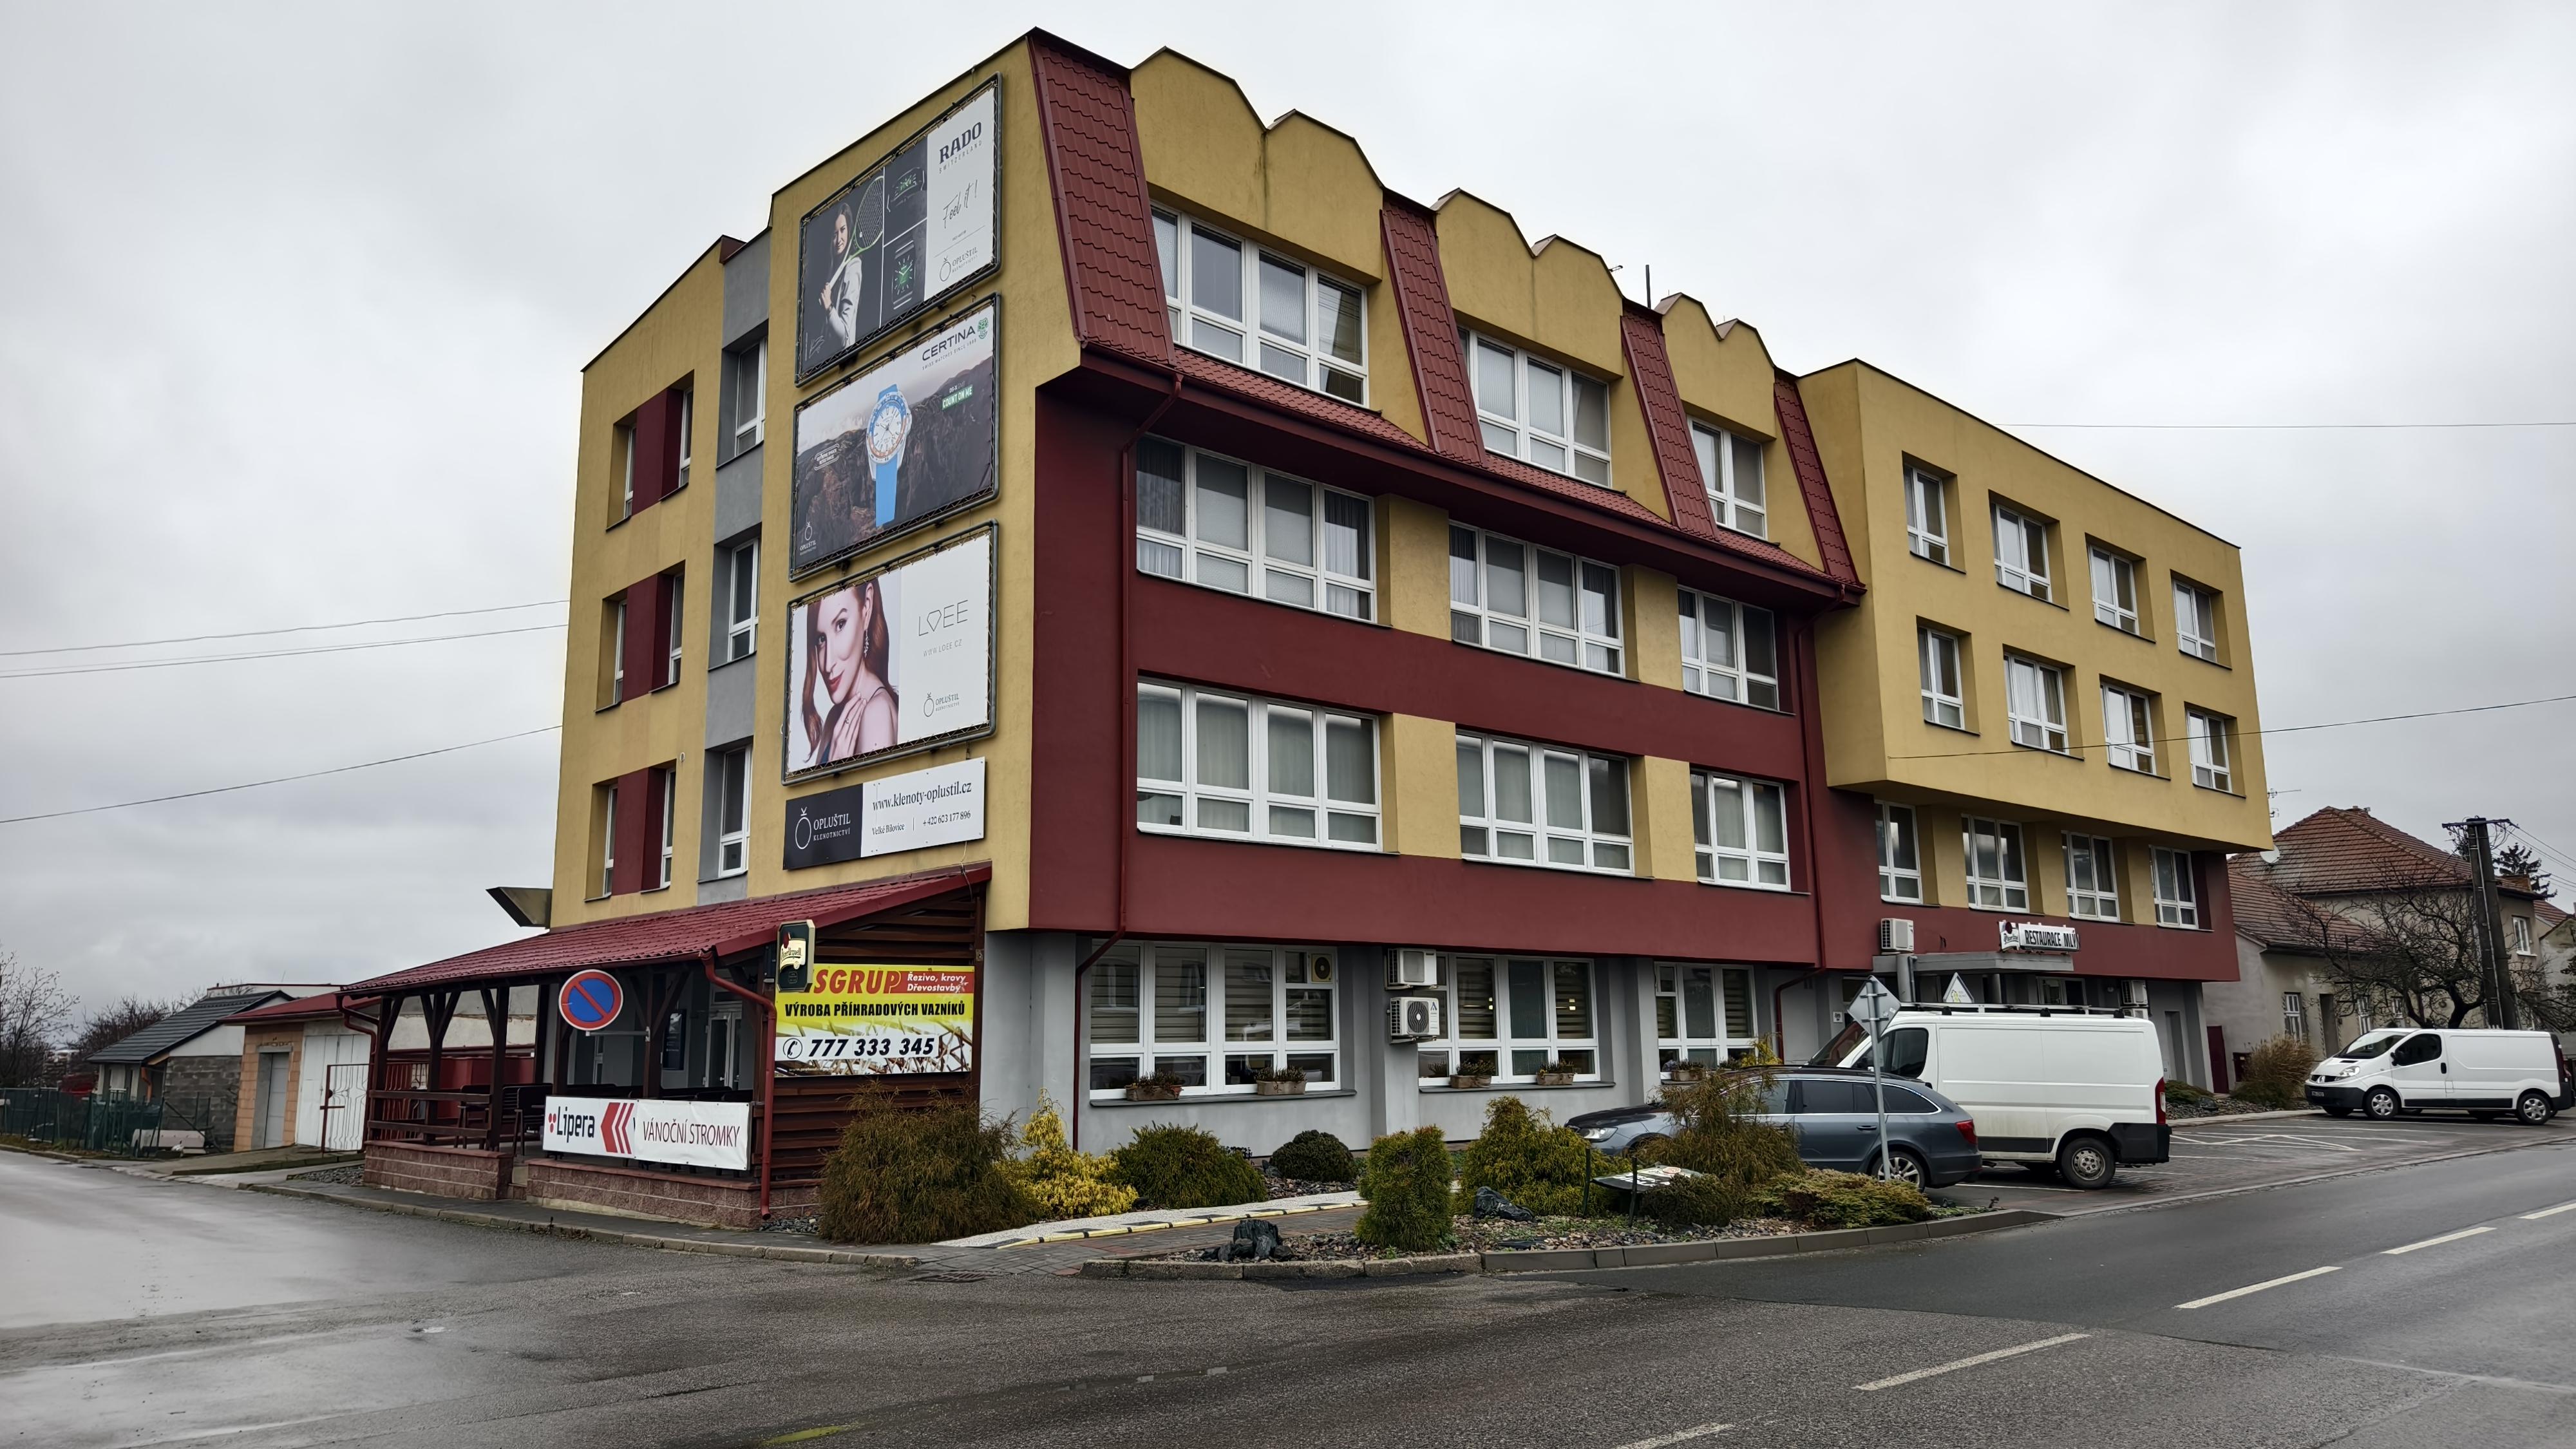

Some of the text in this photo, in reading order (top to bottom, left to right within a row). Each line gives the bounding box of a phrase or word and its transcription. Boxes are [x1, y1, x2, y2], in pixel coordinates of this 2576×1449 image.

[940, 122, 981, 164] RADO
[943, 191, 961, 229] Feel
[922, 326, 976, 361] CERTINA
[942, 386, 972, 408] COUNT ON ME
[918, 600, 969, 636] LOEE
[872, 781, 972, 811] www.klenoty-oplustil.cz
[813, 813, 851, 831] OPLUŠTIL
[938, 813, 948, 823] 603
[949, 812, 959, 822] 177
[960, 810, 971, 820] 896
[813, 827, 851, 842] KLENOTNICTVÍ
[872, 822, 905, 835] Velké Bílovice
[2024, 929, 2062, 947] RESTAURACE
[907, 971, 966, 983] Řezivo, krovy
[907, 983, 961, 994] Dřevostavby
[784, 1000, 965, 1016] VÝROBA PŘÍHRADOVÝCH VAZNÍKŮ
[808, 1037, 934, 1057] 777 333 345
[556, 1106, 595, 1143] Lipera
[643, 1117, 688, 1144] VÁNOČNÍ
[688, 1123, 740, 1147] STROMKY
